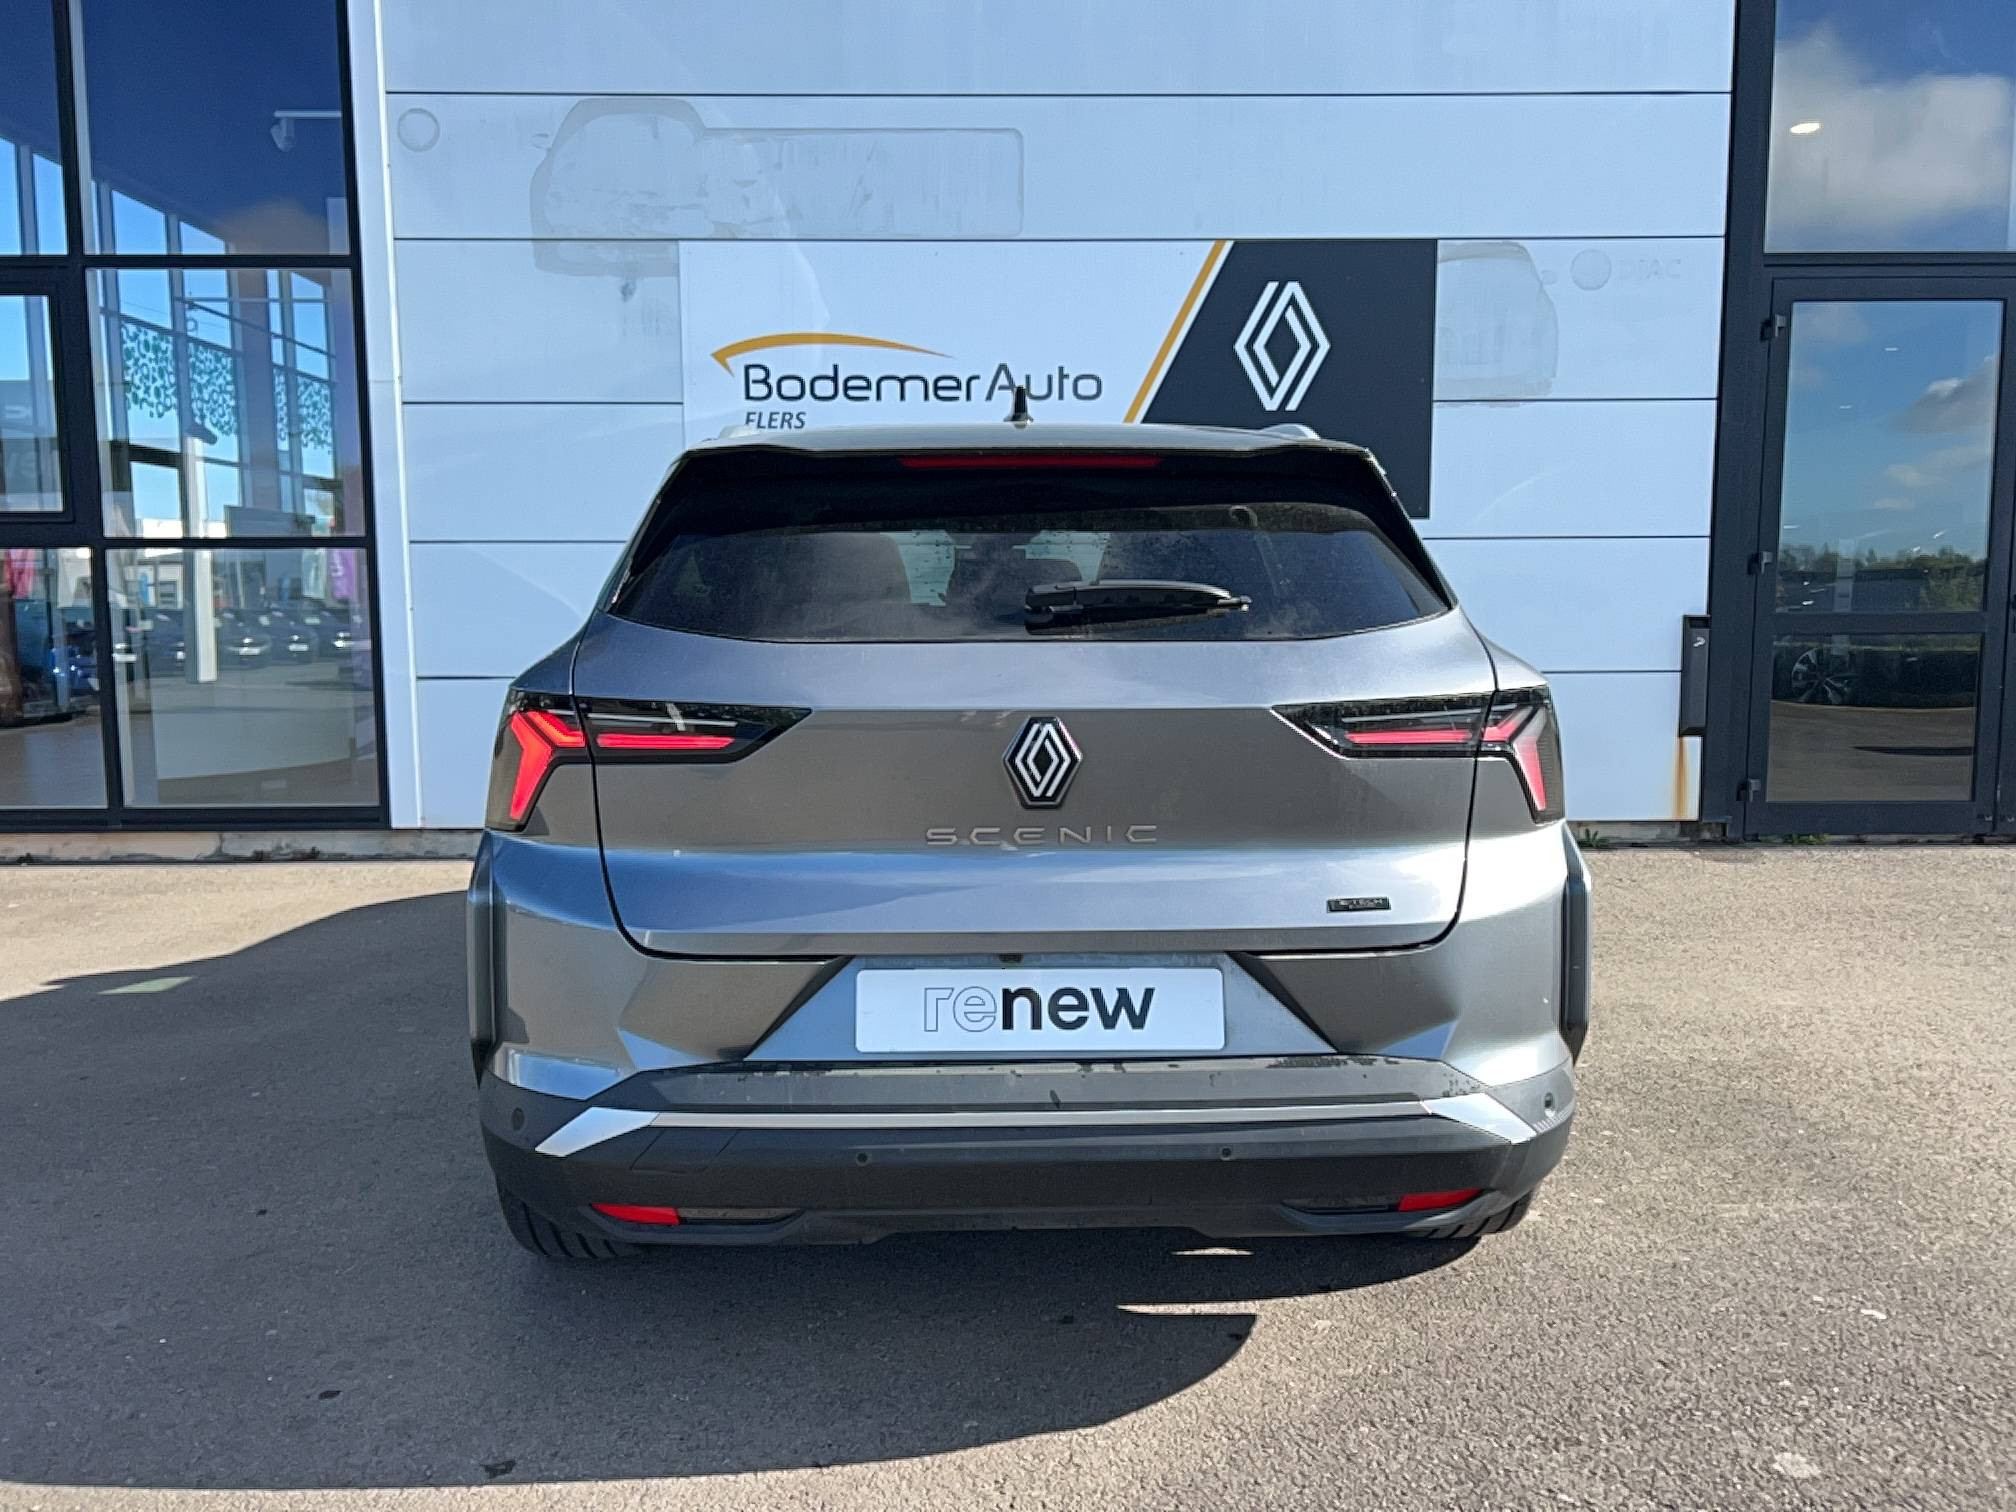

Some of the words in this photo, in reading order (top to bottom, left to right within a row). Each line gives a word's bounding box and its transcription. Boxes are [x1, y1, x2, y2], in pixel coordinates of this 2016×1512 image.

[745, 411, 807, 429] FLERS
[926, 825, 1157, 845] SCENIC
[924, 986, 1155, 1032] renew
